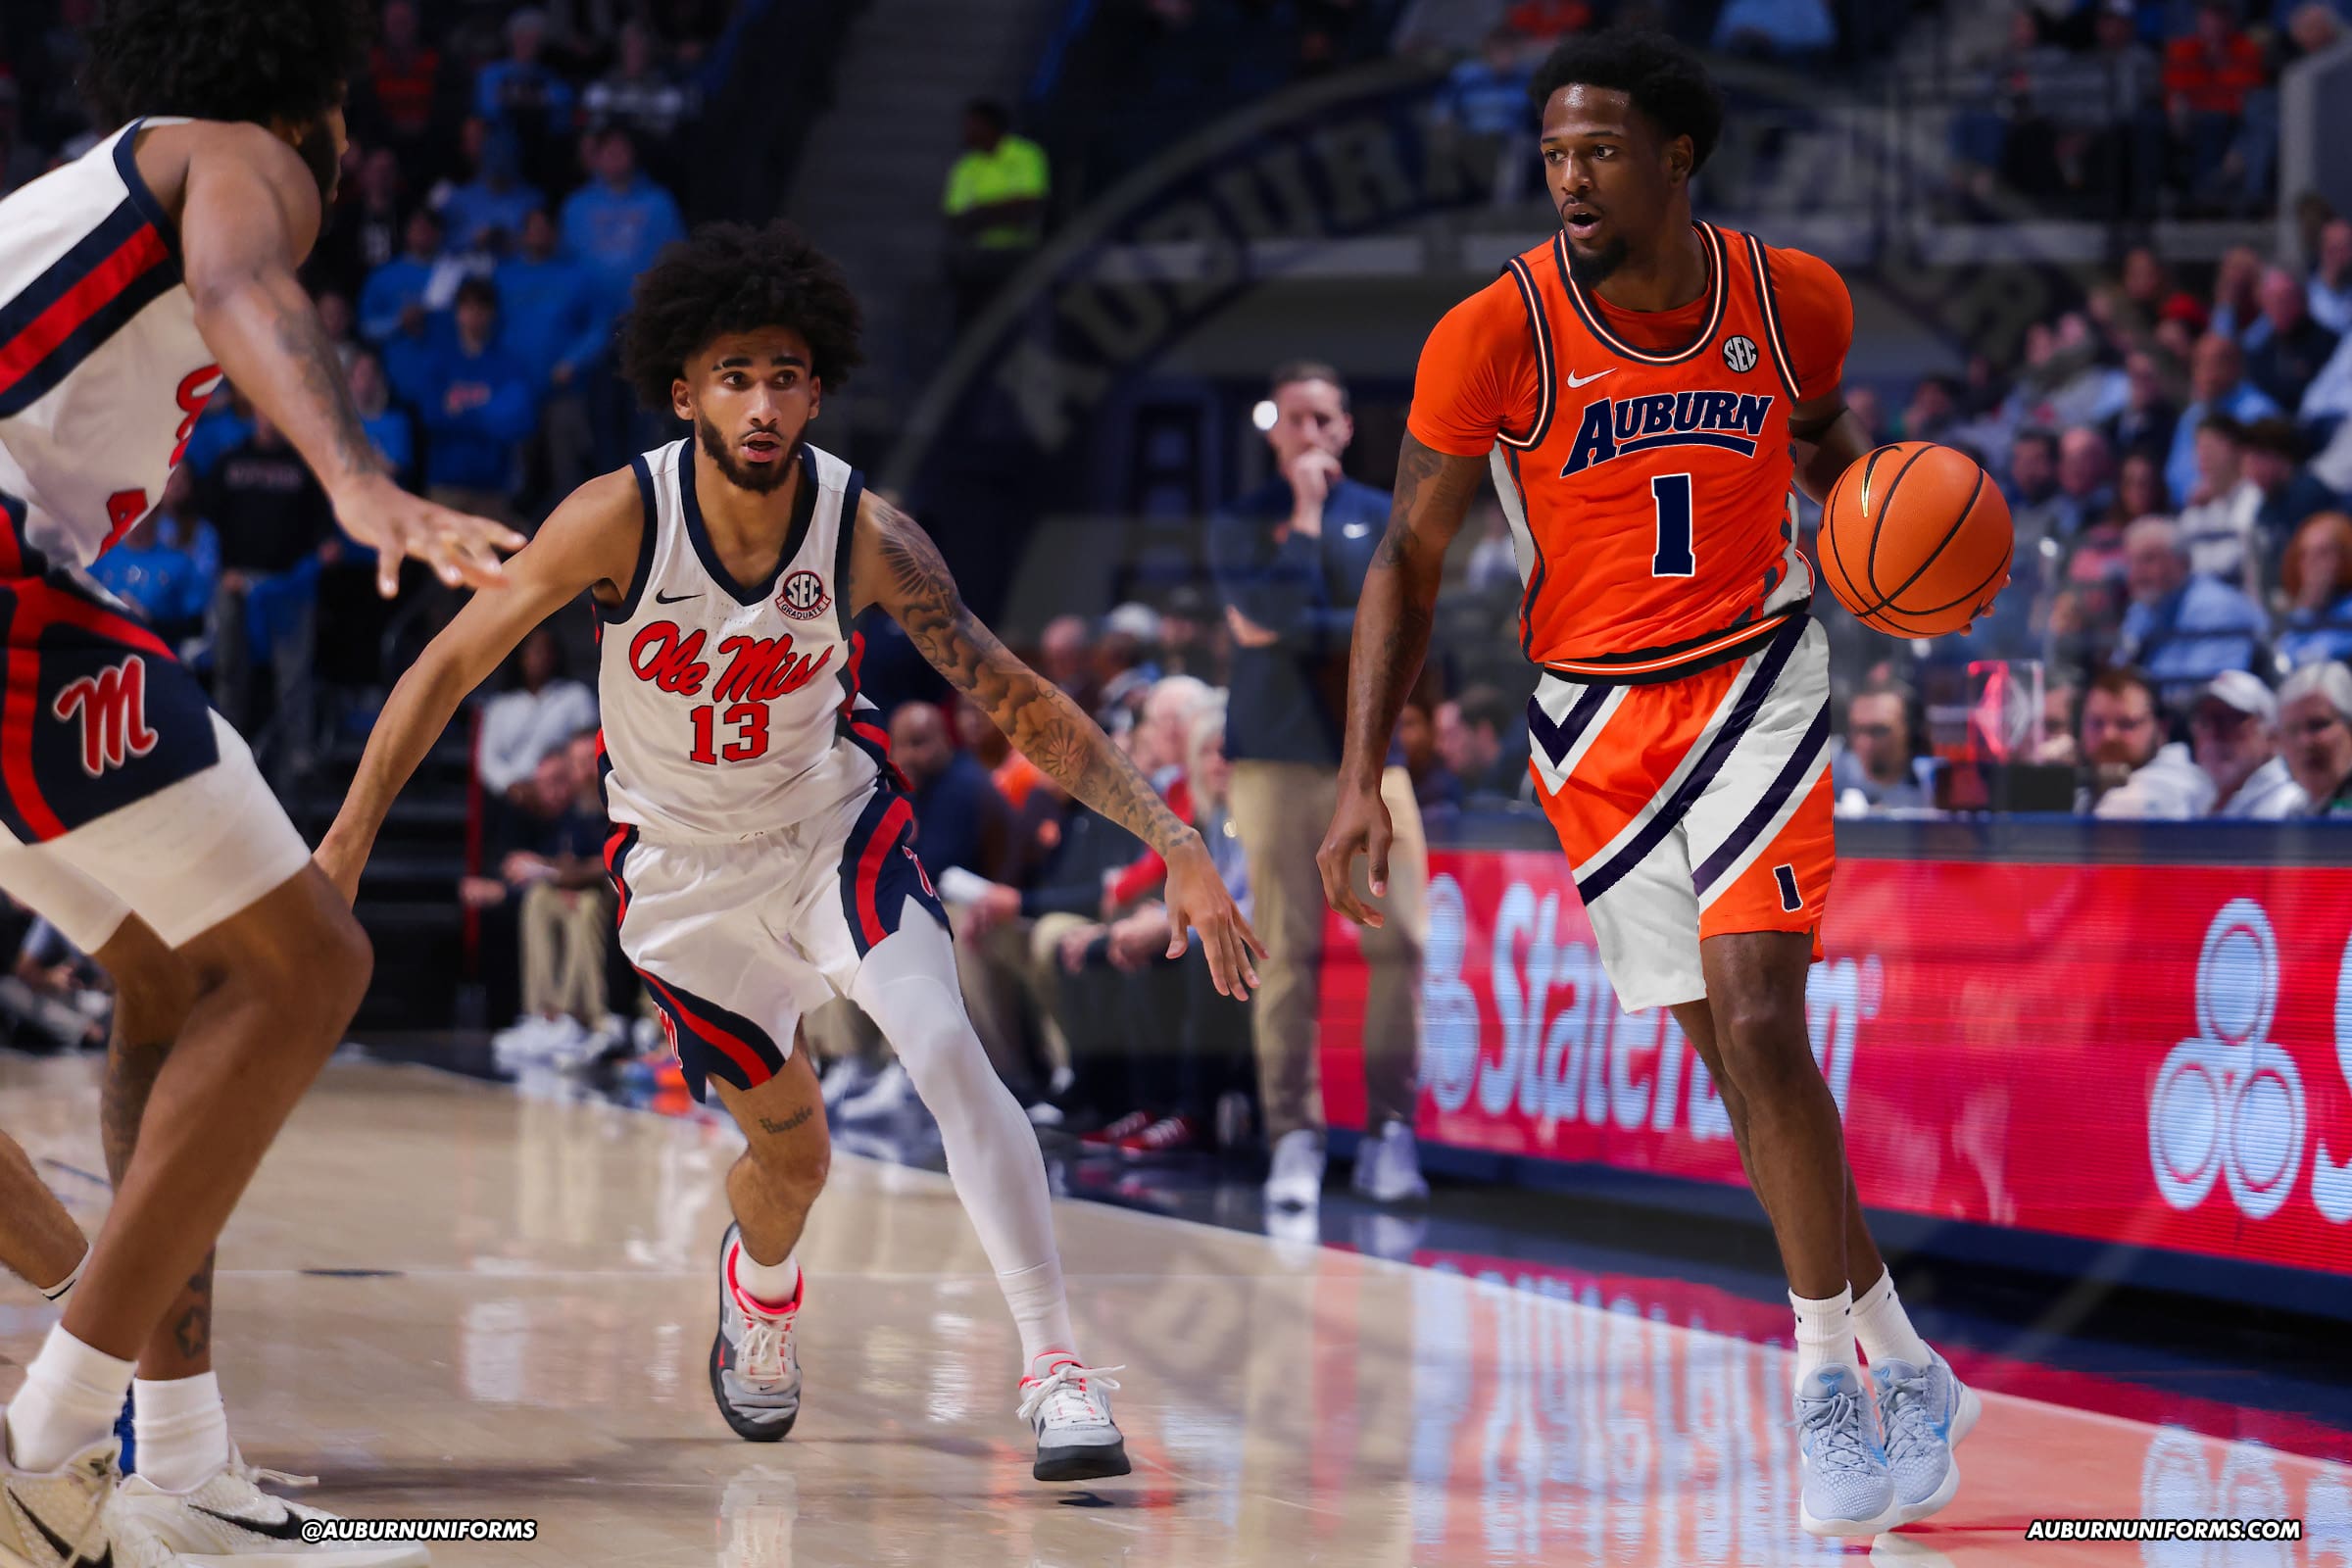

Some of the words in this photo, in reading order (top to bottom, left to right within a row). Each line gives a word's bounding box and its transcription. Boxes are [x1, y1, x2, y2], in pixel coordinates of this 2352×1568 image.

[1724, 336, 1757, 371] SEC
[1559, 391, 1775, 478] AUBURN
[1651, 472, 1696, 577] 1
[781, 604, 824, 619] GRADUATE
[787, 574, 820, 609] SEC
[629, 620, 710, 696] Ole
[690, 702, 769, 765] 13
